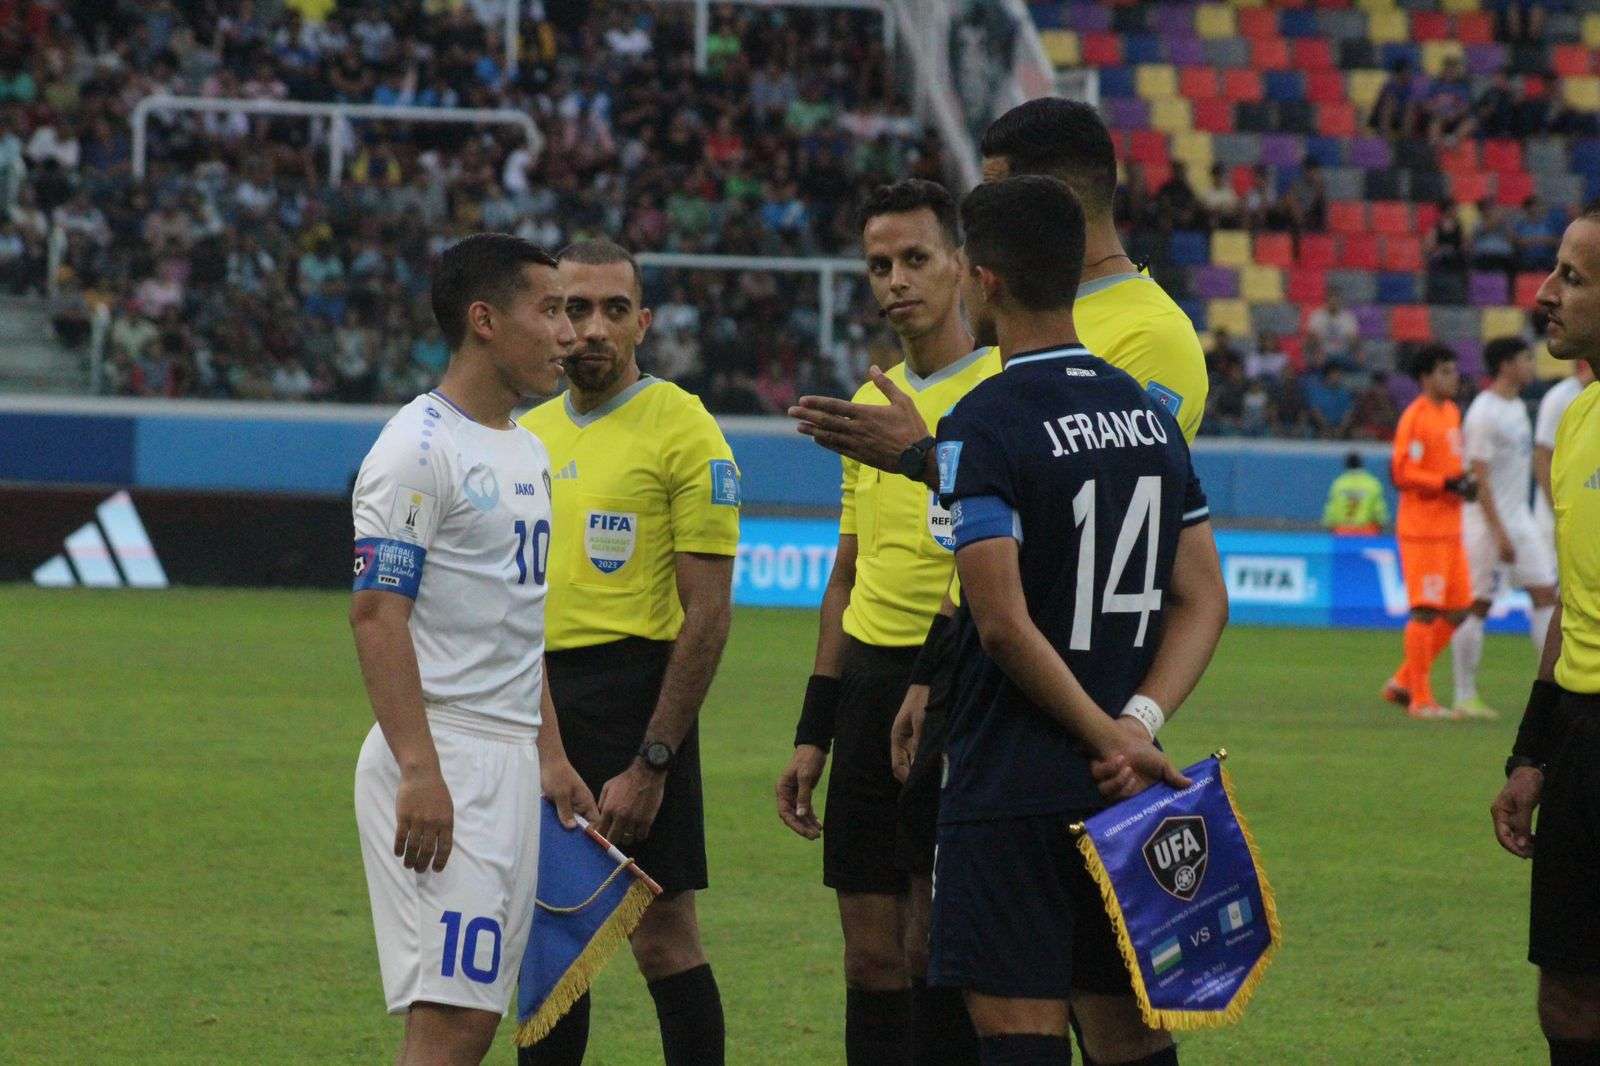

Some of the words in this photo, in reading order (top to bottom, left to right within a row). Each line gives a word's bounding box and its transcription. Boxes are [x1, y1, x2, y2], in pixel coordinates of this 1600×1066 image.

[1043, 409, 1168, 458] J.FRANCO
[514, 482, 535, 496] JAKO
[589, 514, 632, 532] FIFA
[931, 517, 953, 526] REF
[379, 552, 415, 569] UNITES
[380, 544, 416, 559] FOOTBALL
[514, 519, 550, 586] 10
[598, 560, 618, 569] 2023
[1069, 475, 1163, 651] 14
[379, 576, 398, 585] FIFA
[1237, 567, 1295, 588] FIFA
[1153, 828, 1201, 869] UFA
[439, 910, 502, 985] 10
